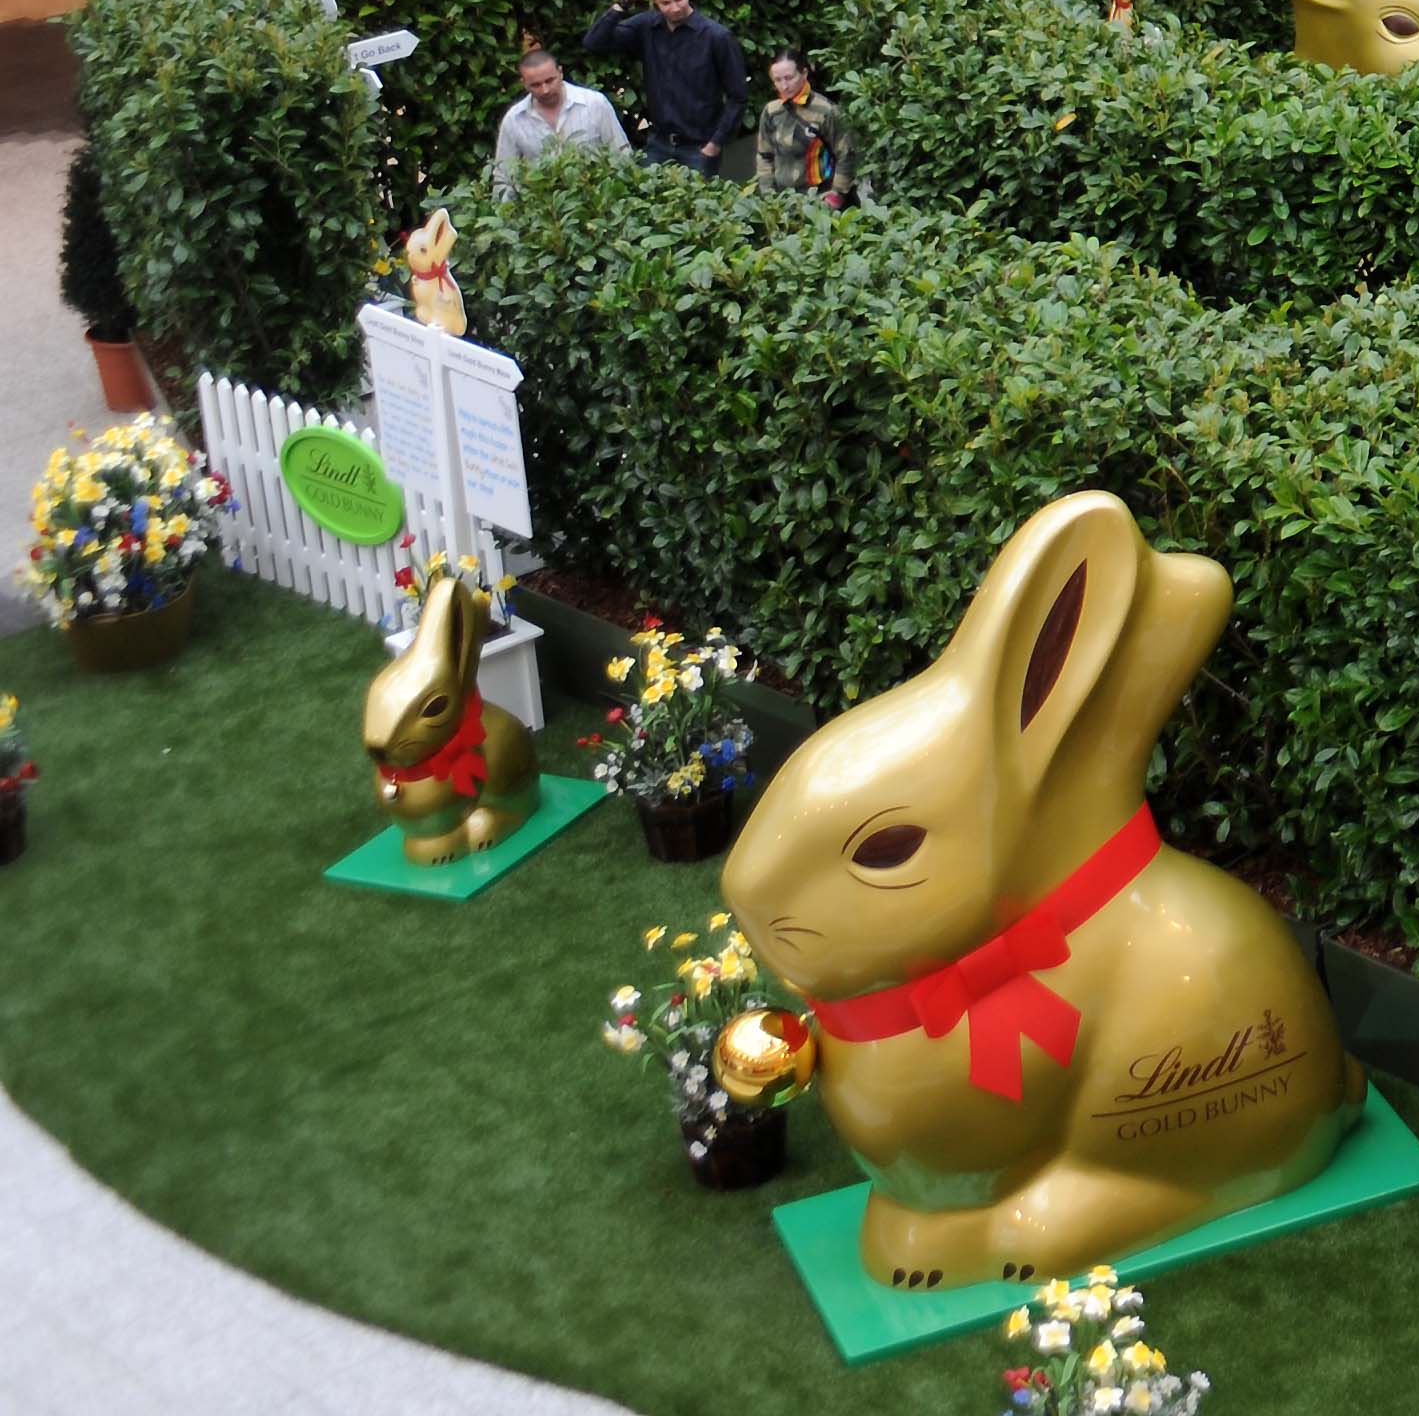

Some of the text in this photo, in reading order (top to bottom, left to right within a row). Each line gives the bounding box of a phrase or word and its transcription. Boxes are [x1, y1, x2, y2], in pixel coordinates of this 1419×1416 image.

[361, 49, 375, 59] Go
[378, 42, 401, 56] Back
[306, 448, 360, 486] Lindt
[1115, 1025, 1254, 1102] Lindt
[1117, 1072, 1293, 1142] GOLD BUNNY
